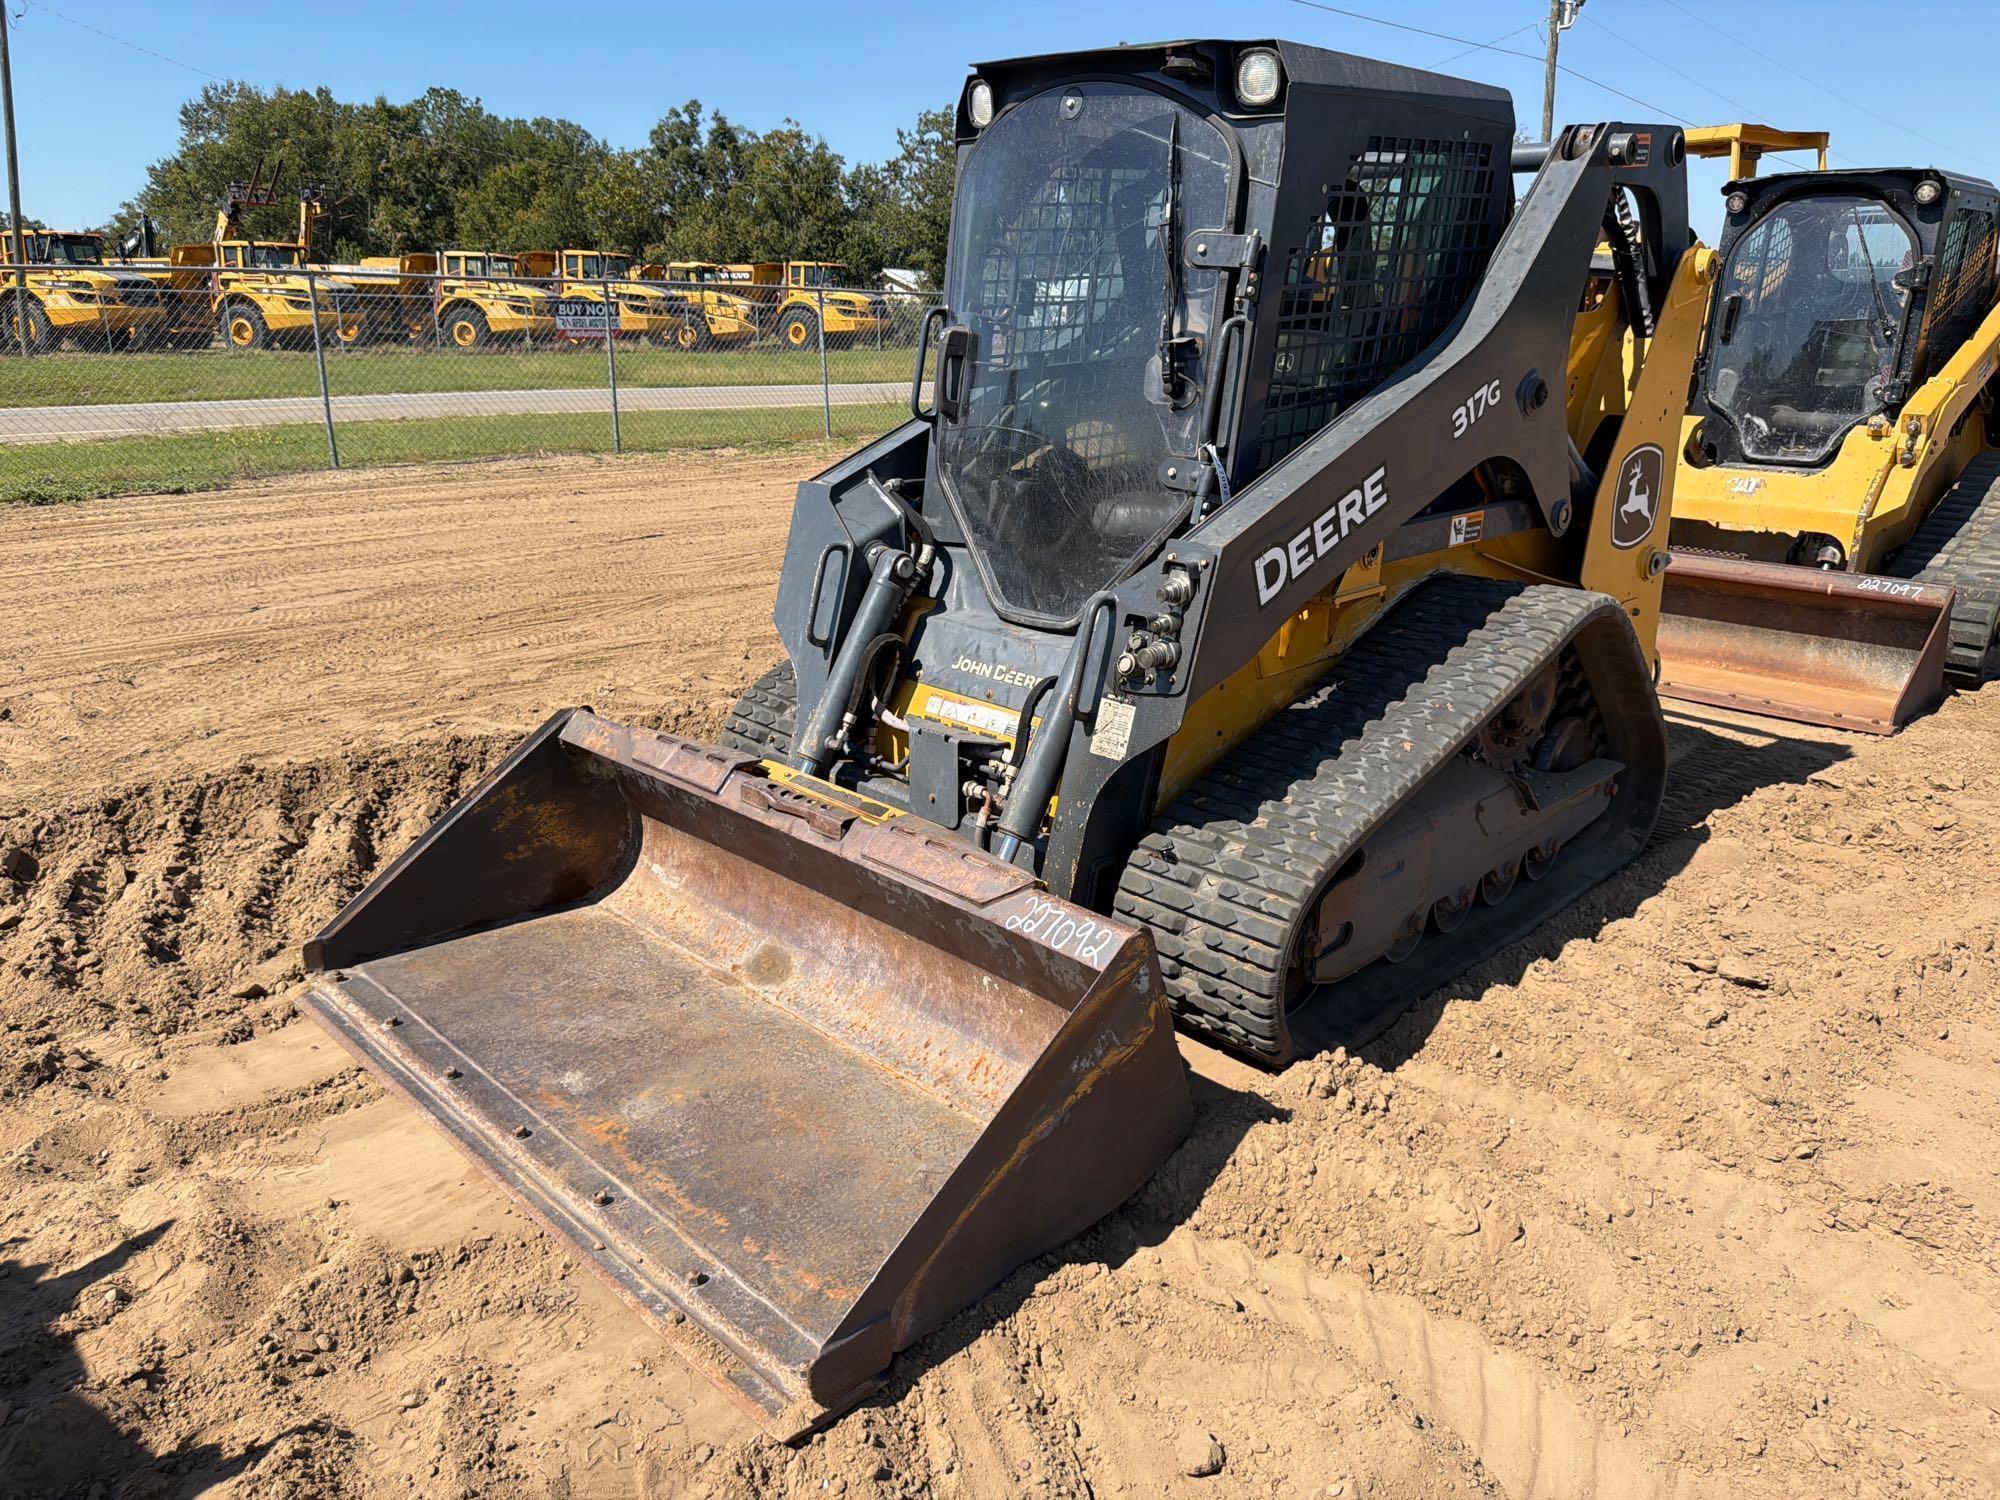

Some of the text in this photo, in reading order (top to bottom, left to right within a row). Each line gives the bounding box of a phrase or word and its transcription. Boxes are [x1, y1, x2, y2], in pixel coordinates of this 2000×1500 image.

[558, 303, 582, 316] BUY
[1451, 379, 1501, 439] 317G
[1217, 462, 1229, 496] 7092
[1254, 466, 1388, 607] DEERE
[1857, 579, 1924, 599] 227097
[951, 654, 993, 678] JOHN
[1005, 896, 1112, 967] 227092
